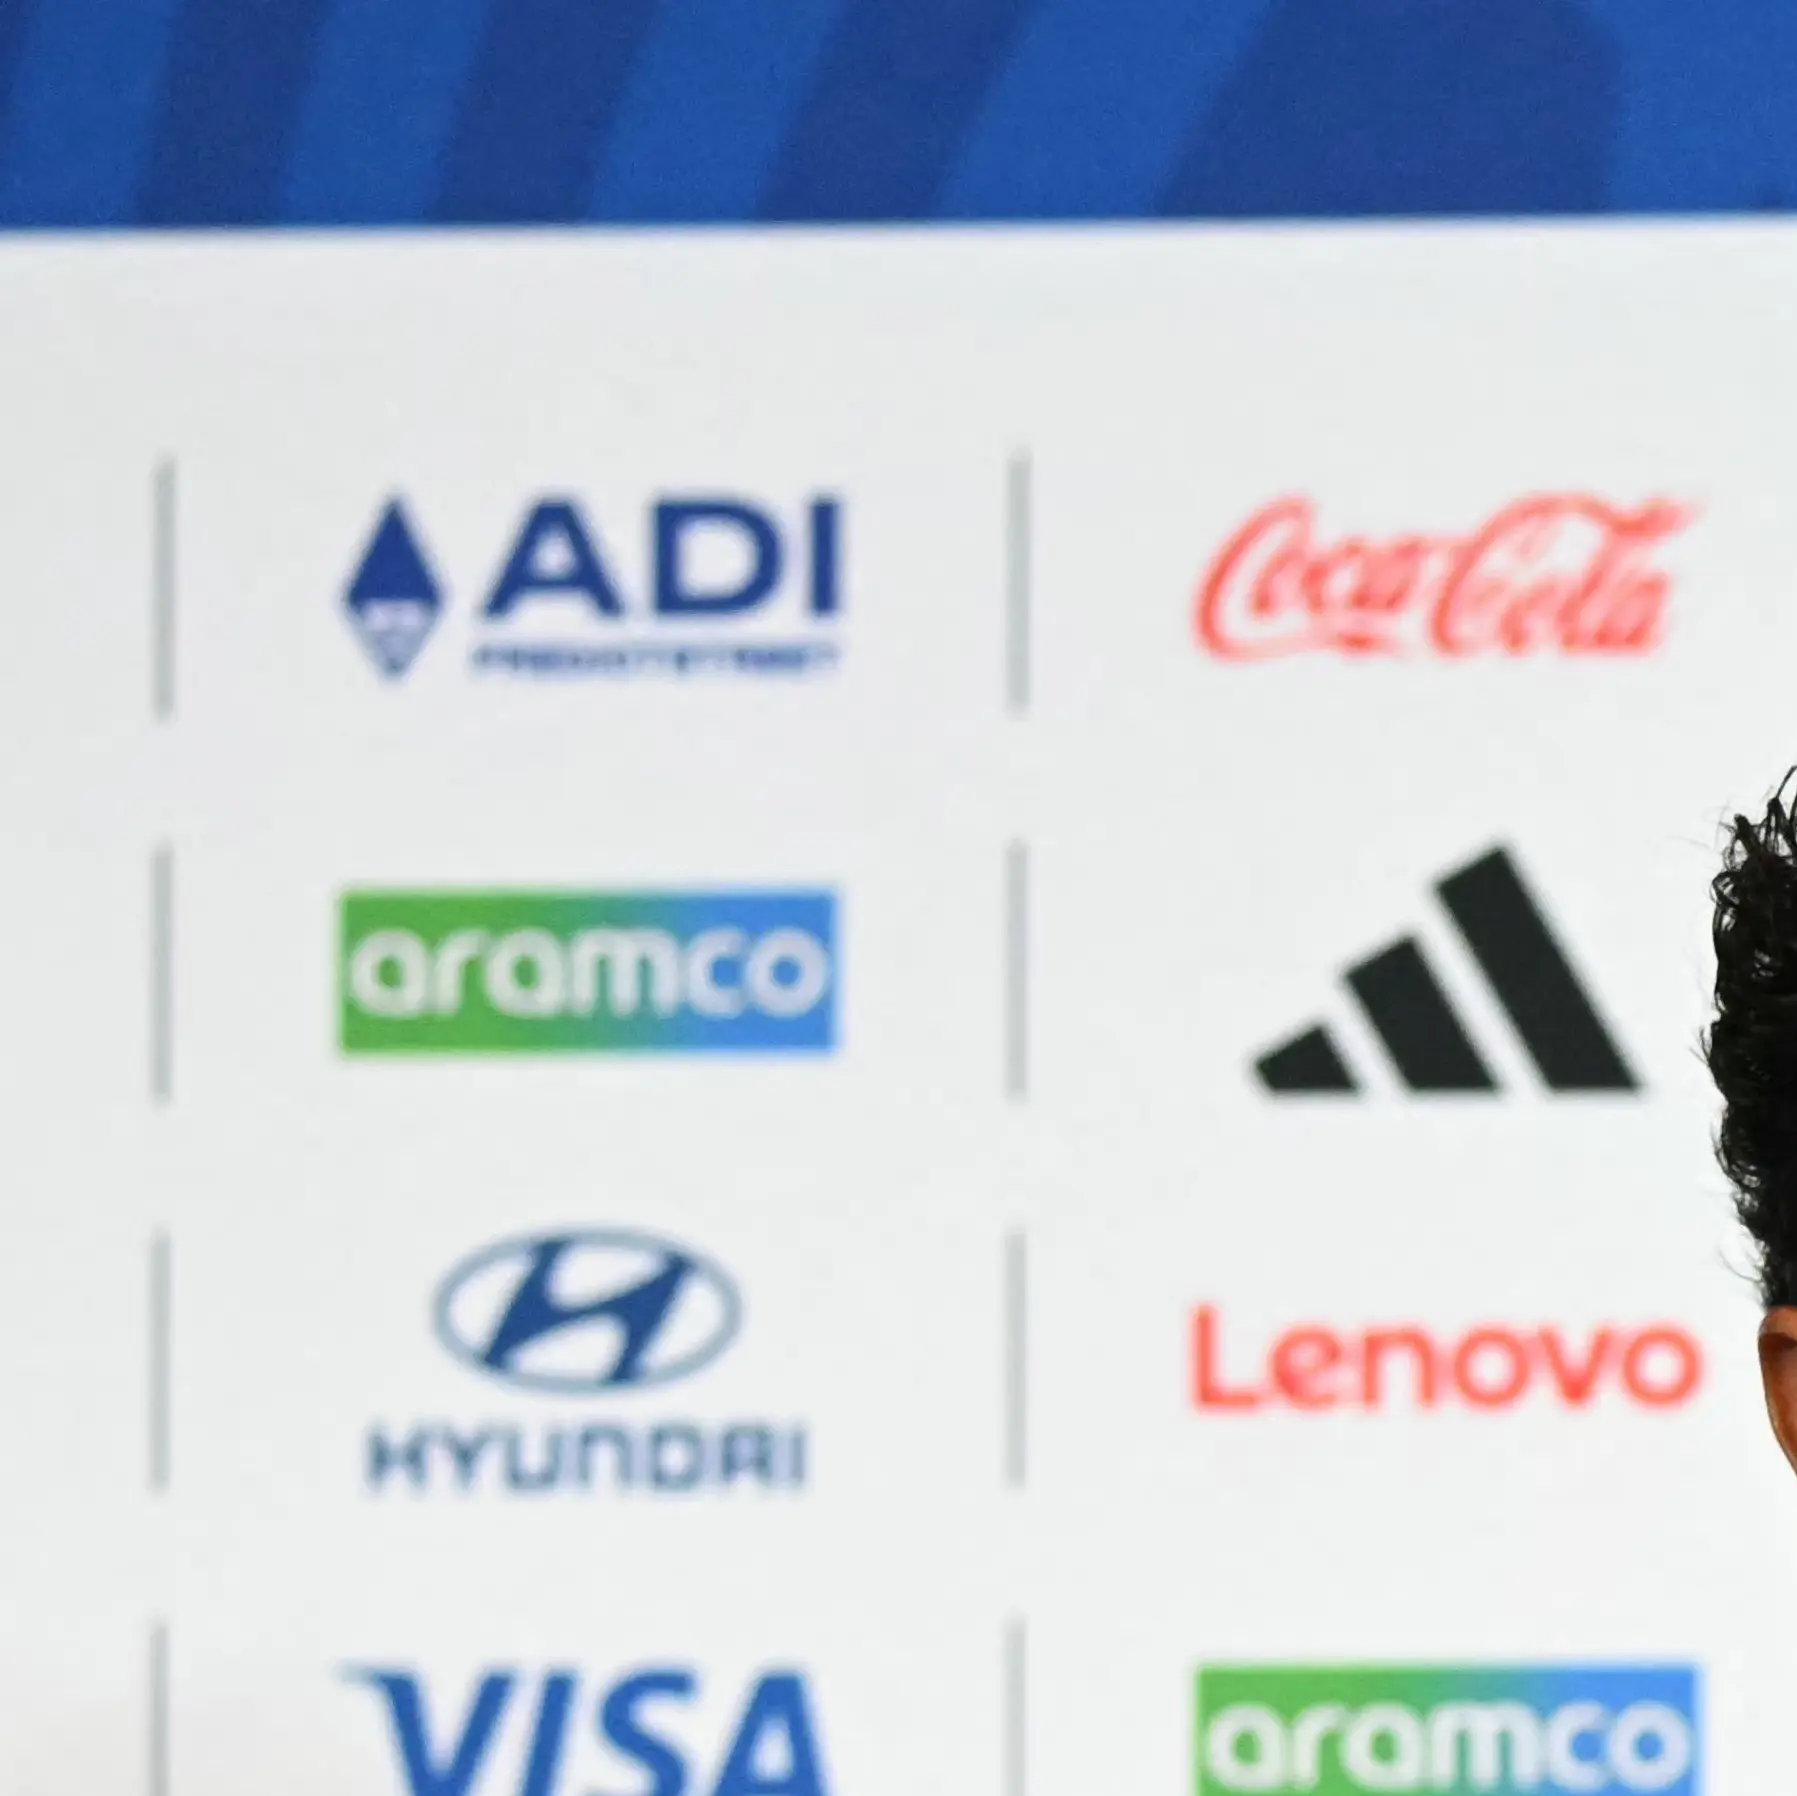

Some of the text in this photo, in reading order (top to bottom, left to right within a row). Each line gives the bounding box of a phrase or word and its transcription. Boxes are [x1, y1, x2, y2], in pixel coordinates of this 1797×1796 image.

[478, 493, 842, 622] ADI
[1192, 494, 1690, 661] Coca-Cola
[346, 927, 834, 1020] aramco
[1190, 1304, 1704, 1414] Lenovo
[366, 1421, 806, 1493] HYUNDAI
[1204, 1702, 1692, 1791] aramco
